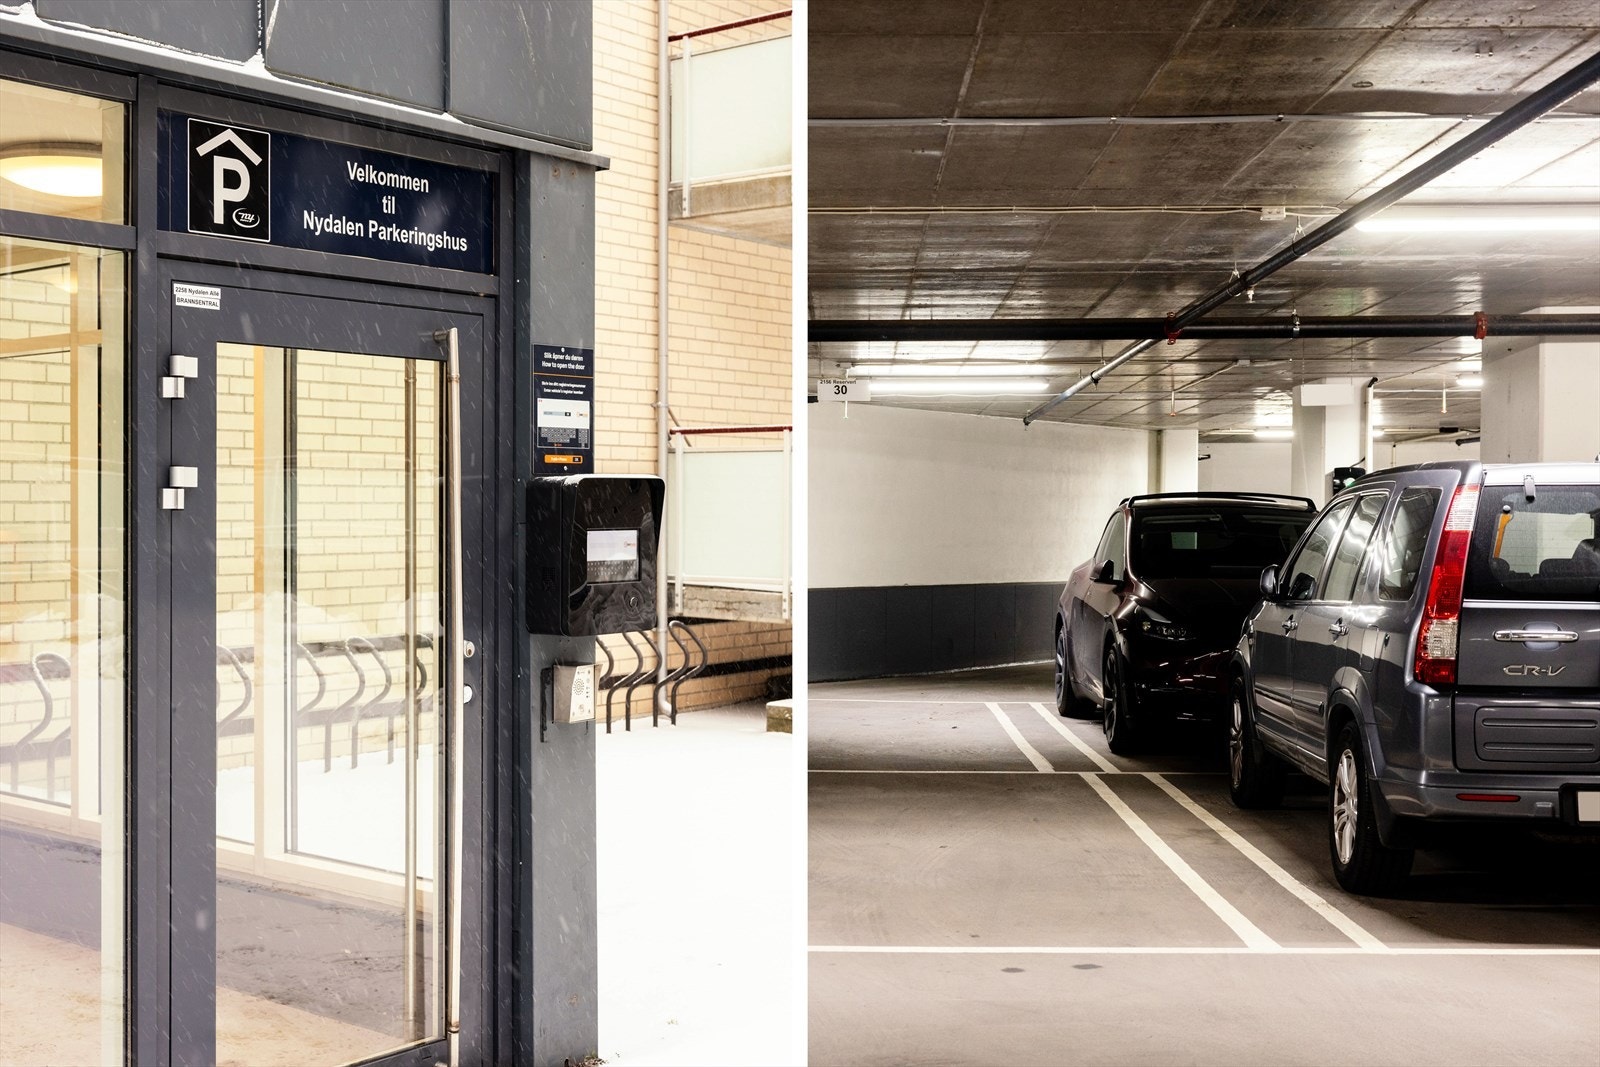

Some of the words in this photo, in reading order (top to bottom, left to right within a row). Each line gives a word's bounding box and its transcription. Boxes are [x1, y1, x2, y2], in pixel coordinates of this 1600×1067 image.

[346, 160, 430, 193] Velkommen
[213, 155, 251, 225] P
[381, 195, 396, 215] til
[303, 209, 364, 237] Nydalen
[368, 220, 468, 252] Parkeringshus
[188, 288, 209, 296] Nydalen
[176, 297, 219, 308] BRANNSENTRAL
[834, 384, 848, 394] 30
[1503, 664, 1567, 677] CR-V
